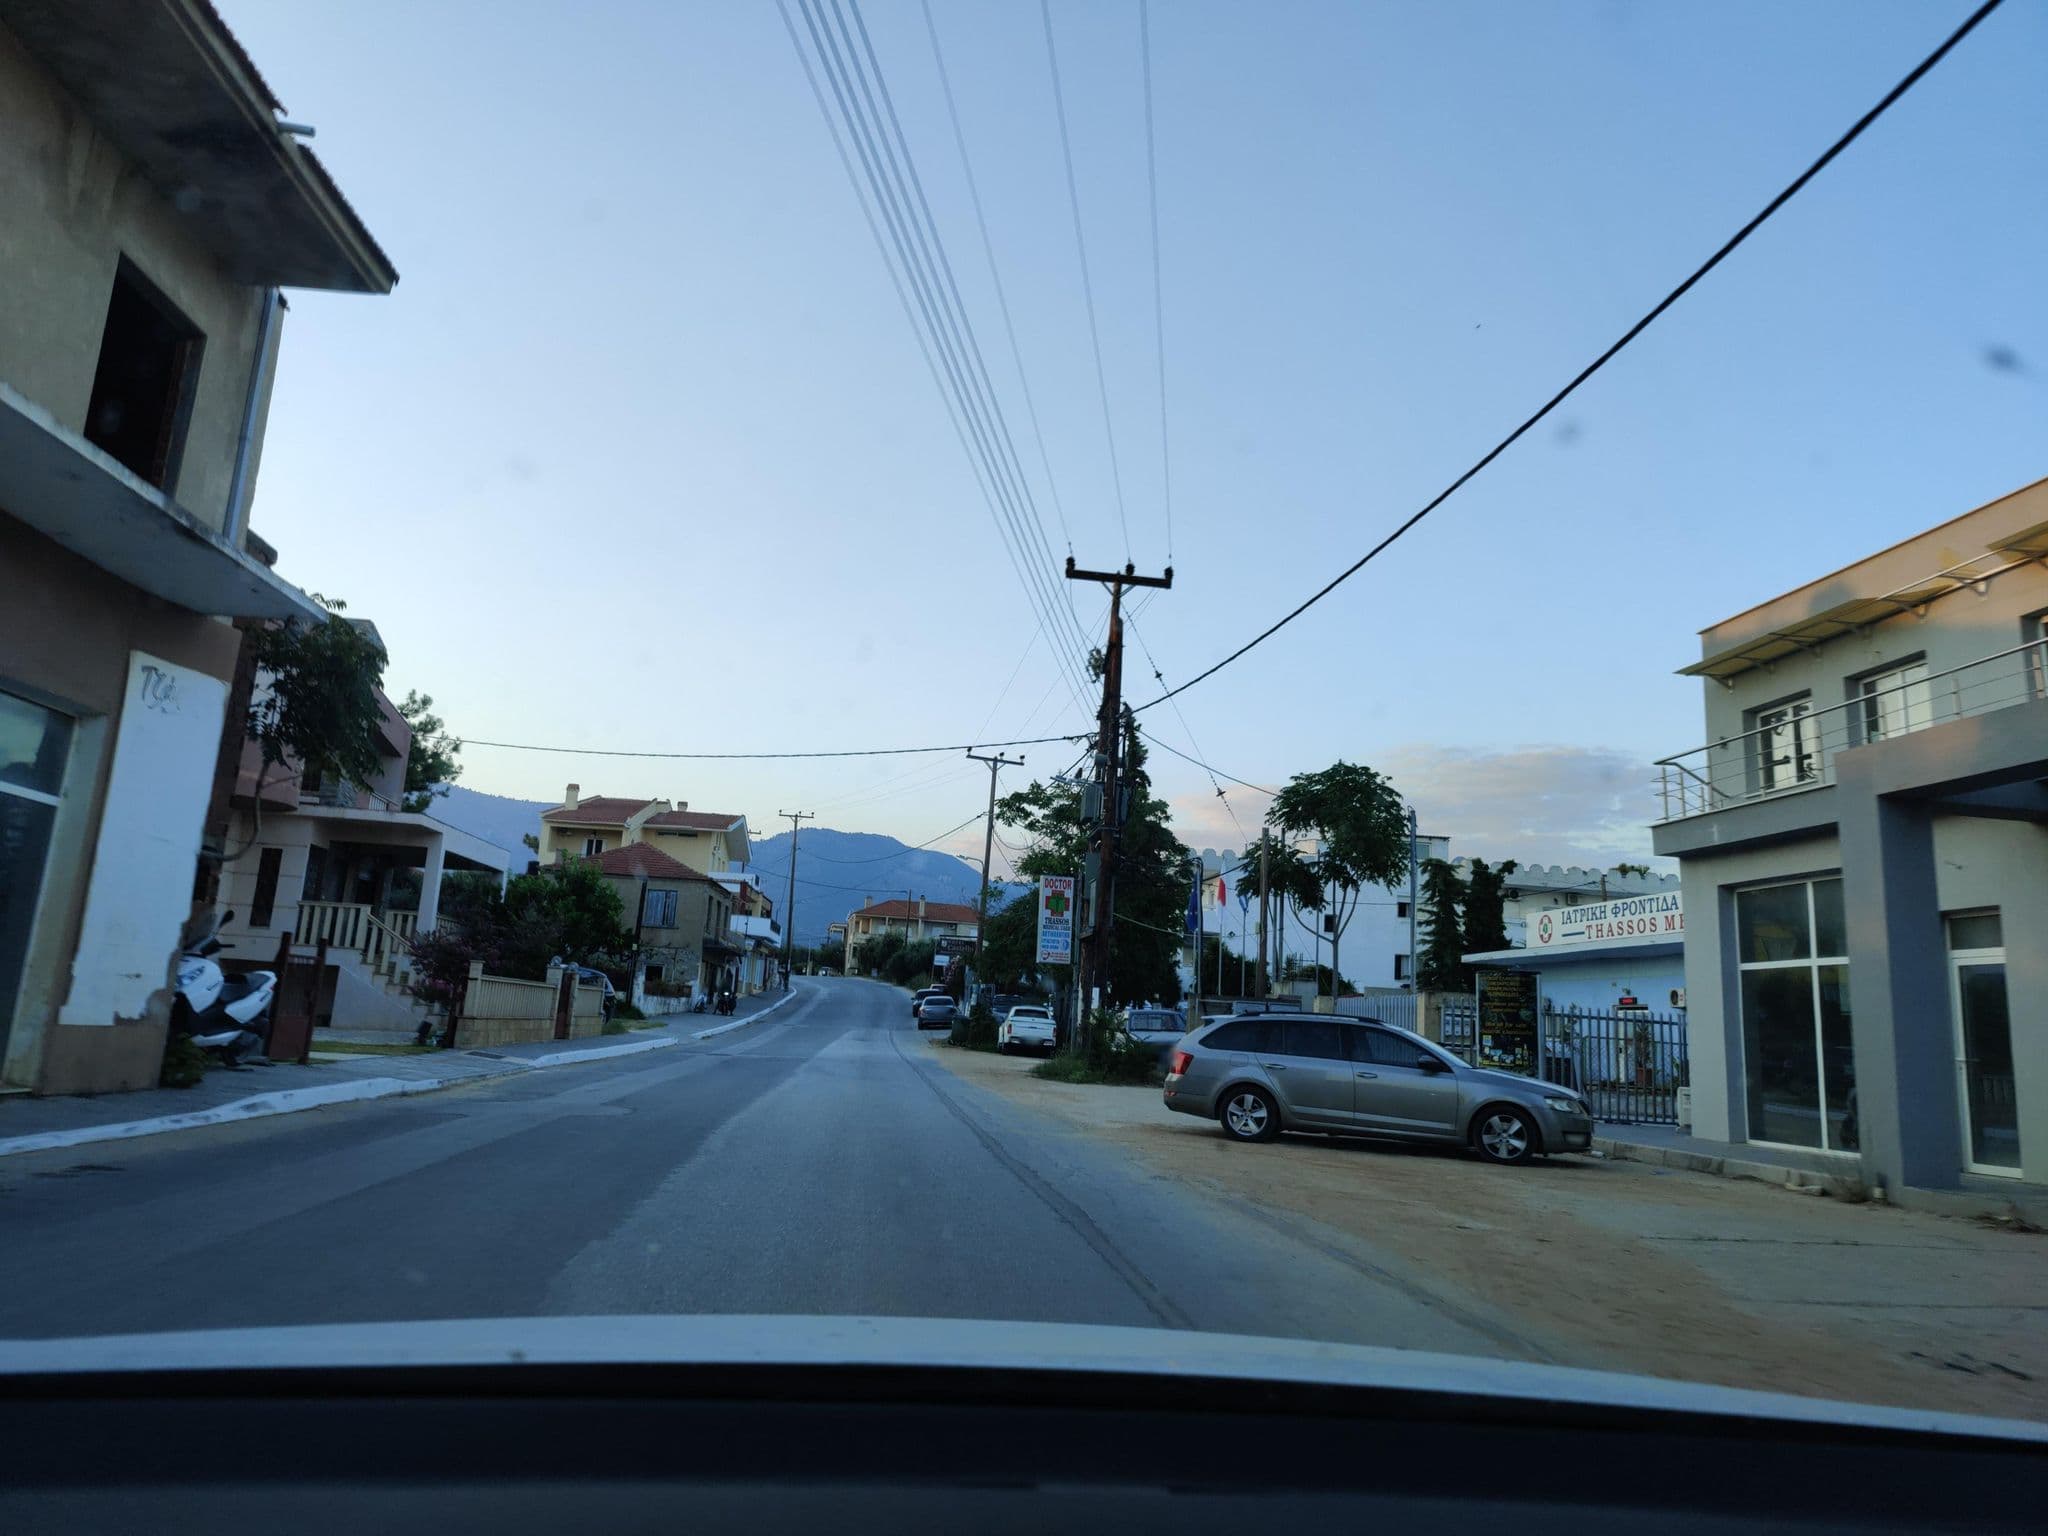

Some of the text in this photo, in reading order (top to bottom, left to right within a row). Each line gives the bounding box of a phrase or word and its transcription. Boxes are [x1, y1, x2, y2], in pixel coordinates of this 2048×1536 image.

[1044, 878, 1072, 890] DOCTOR
[1561, 894, 1680, 925] ΙΑΤΡΙΚΗ ΦΡΟΝΤΙΔΑ
[1585, 916, 1658, 940] THASSOS
